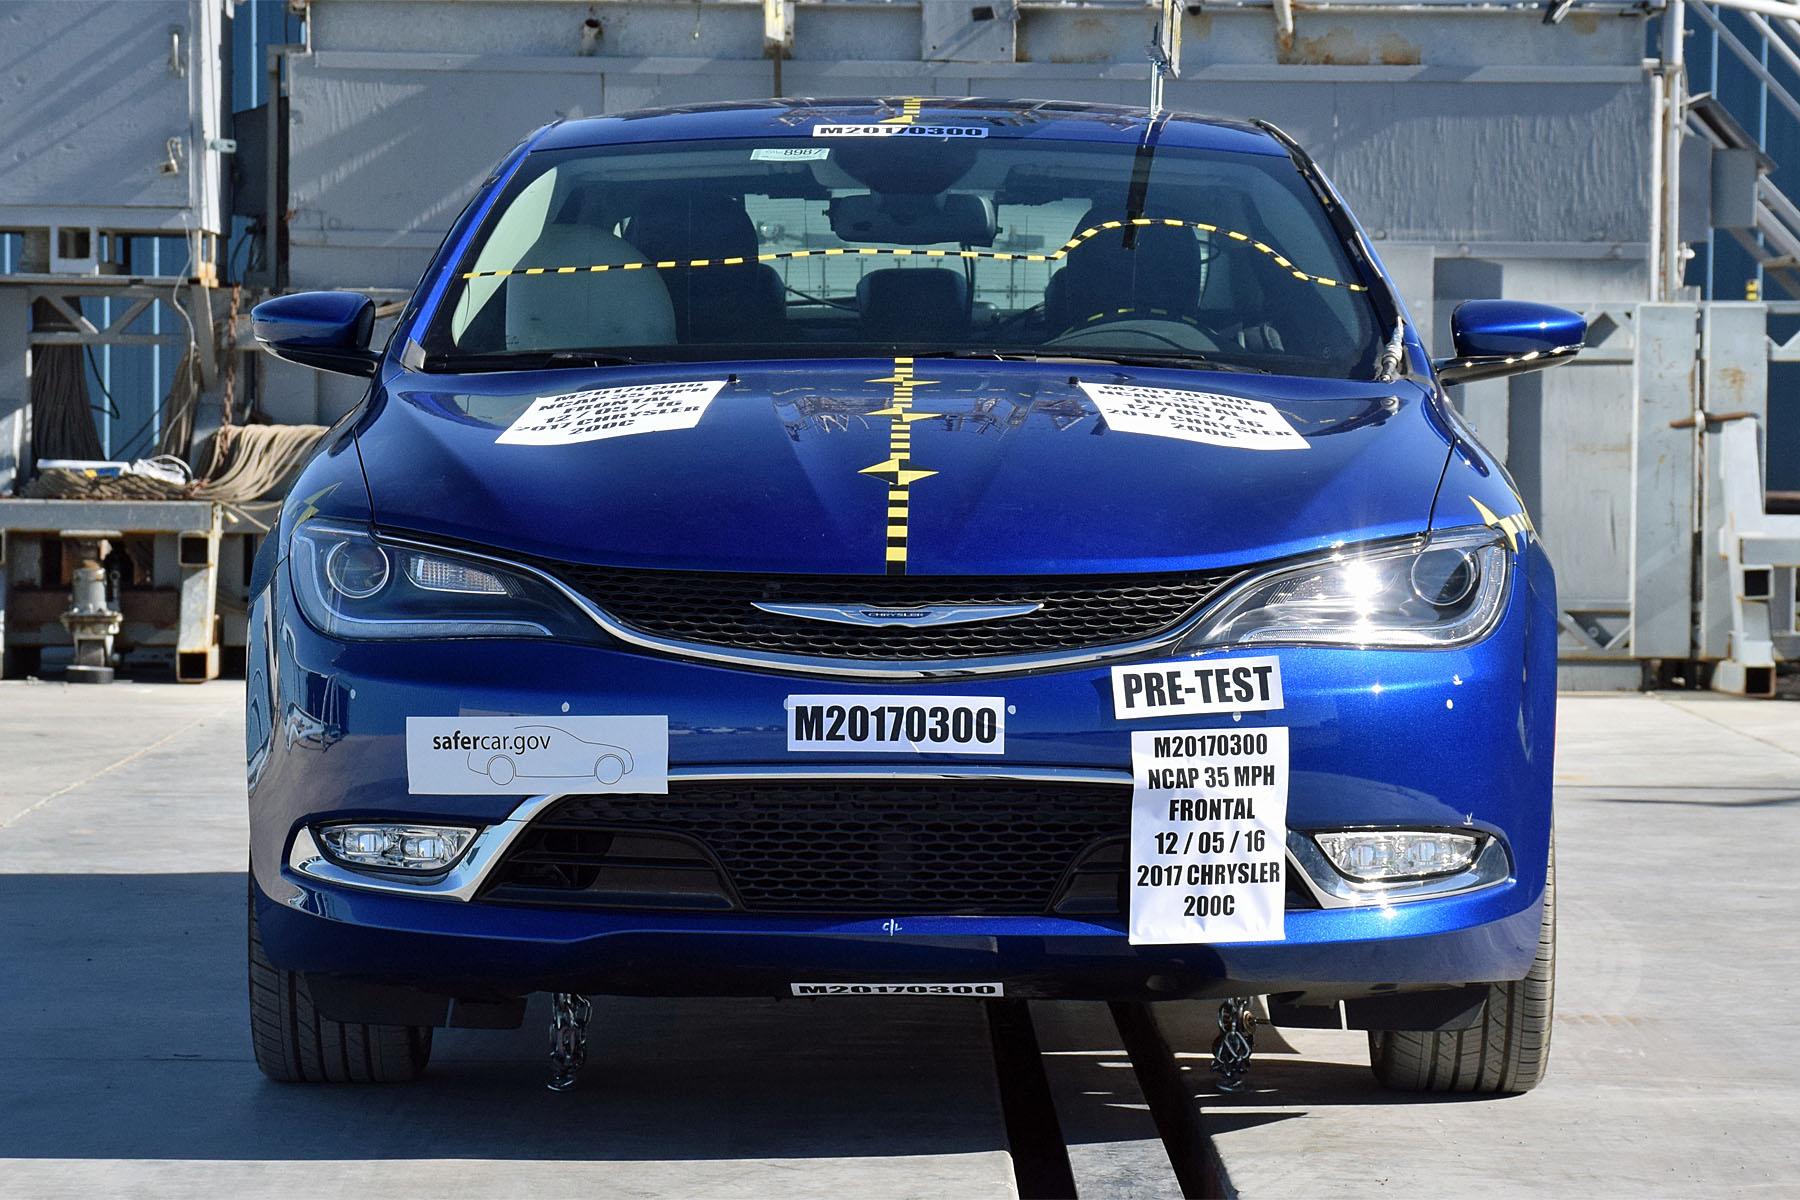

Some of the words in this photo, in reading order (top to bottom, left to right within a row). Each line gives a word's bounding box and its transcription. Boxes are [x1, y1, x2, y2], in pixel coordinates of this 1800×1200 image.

[820, 127, 983, 136] M20170300
[539, 396, 606, 411] NCAP
[652, 387, 708, 396] MPH
[563, 396, 670, 414] FRONTAL
[514, 422, 572, 432] 2017
[577, 406, 700, 426] CHRYSLER
[568, 419, 635, 435] 200C
[1168, 415, 1293, 436] CHRYSLER
[1171, 422, 1237, 438] 200C
[1123, 666, 1273, 708] PRE-TEST
[795, 705, 997, 743] M20170300
[433, 731, 550, 754] safercar.gov
[1154, 734, 1267, 758] M20170300
[1148, 767, 1199, 789] NCAP
[1205, 767, 1229, 787] 35
[1235, 765, 1275, 786] MPH
[1169, 798, 1255, 821] FRONTAL
[1154, 832, 1178, 854] 12
[1183, 832, 1193, 854] /
[1200, 831, 1224, 853] 05
[1229, 831, 1240, 853] /
[1244, 829, 1265, 852] 16
[1137, 865, 1183, 886] 2017
[1187, 862, 1280, 885] CHRYSLER
[1184, 895, 1235, 916] 200C
[800, 985, 996, 994] M20170300
